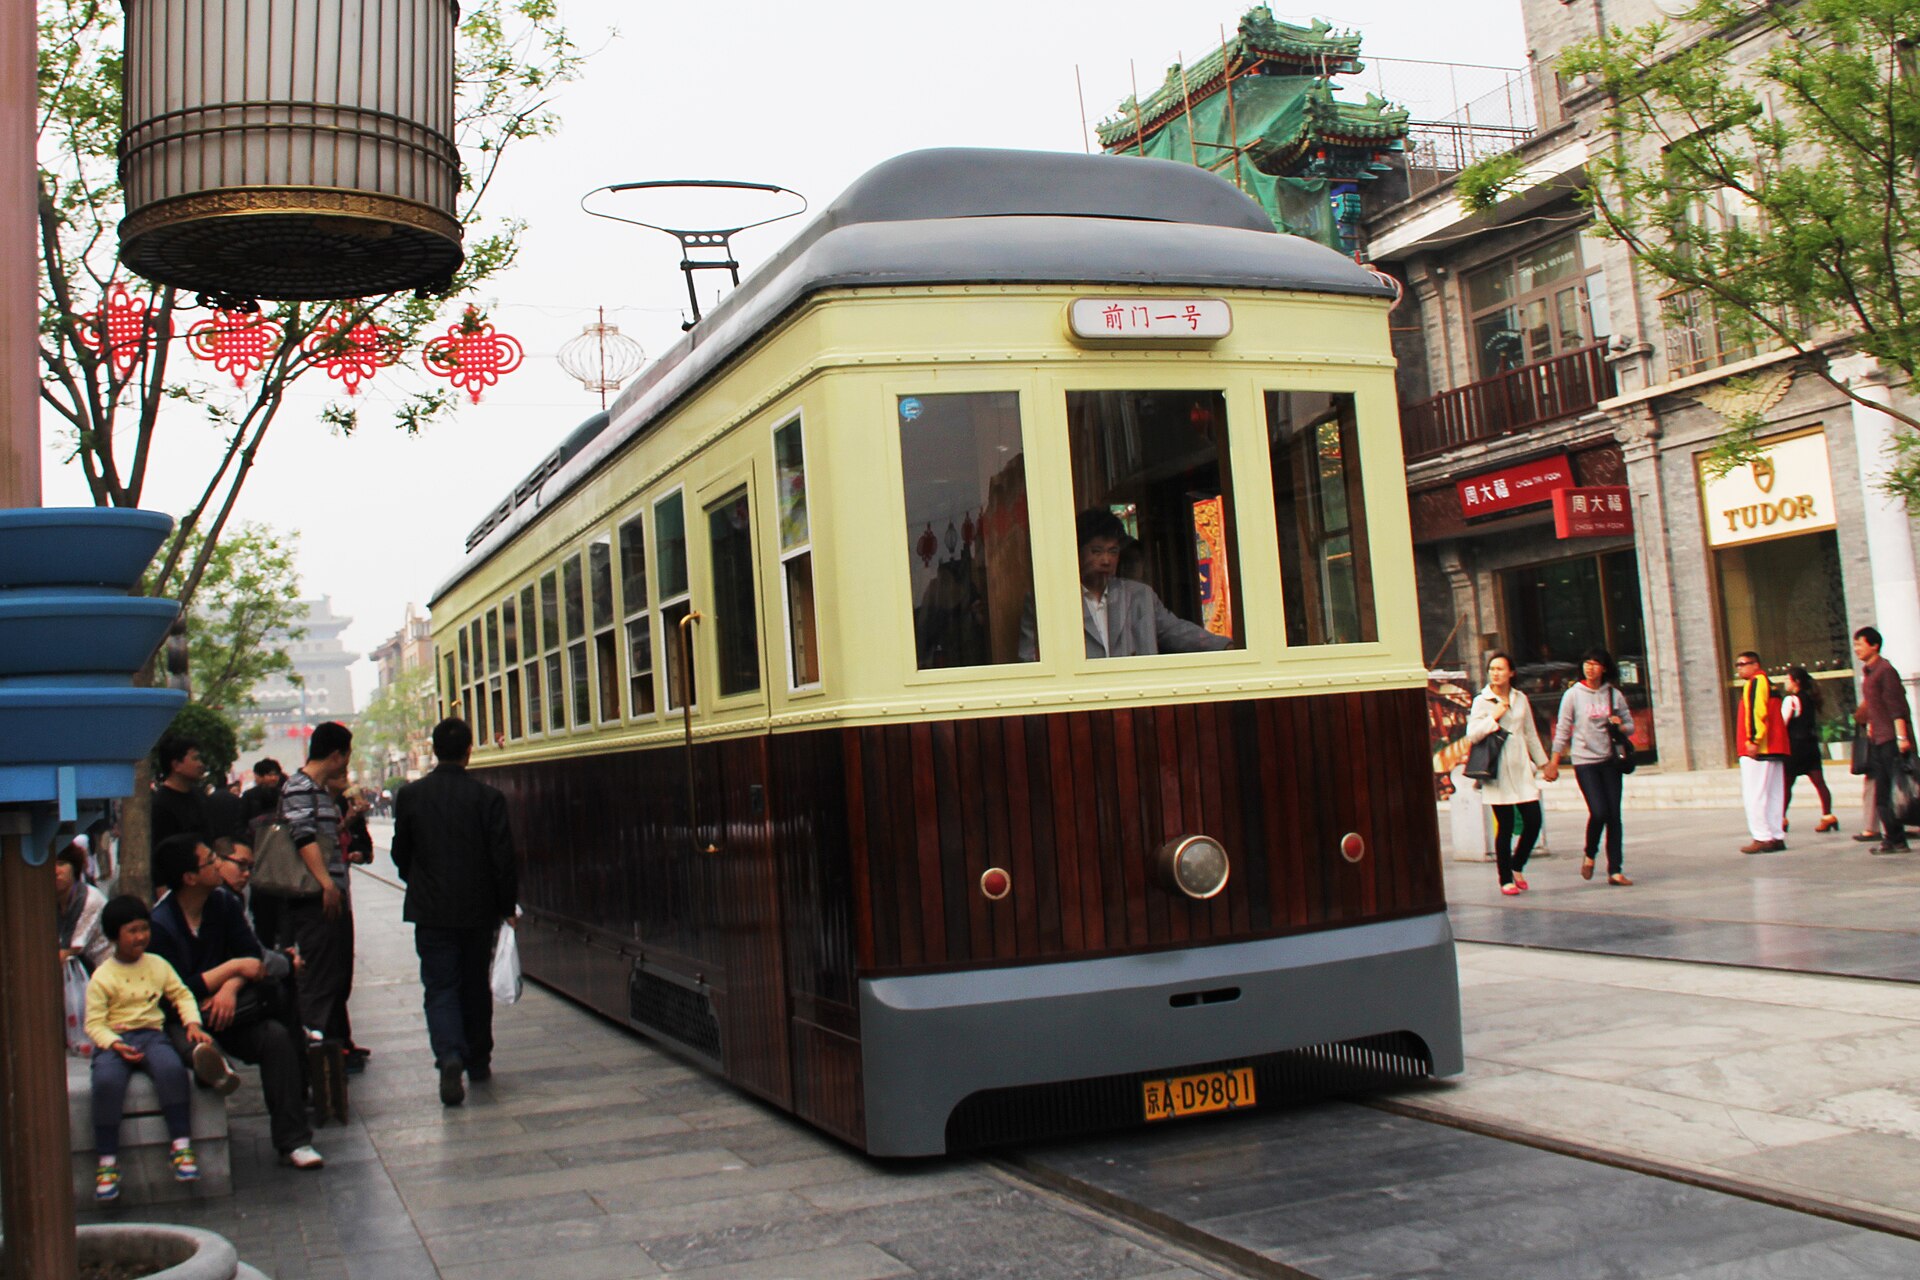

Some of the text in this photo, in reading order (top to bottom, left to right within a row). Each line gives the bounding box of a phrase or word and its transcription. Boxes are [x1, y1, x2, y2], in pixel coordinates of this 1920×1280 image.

[1102, 303, 1201, 331] 前门一号
[1464, 478, 1510, 506] 周大福
[1572, 494, 1623, 514] 周大福
[1722, 494, 1818, 532] TUDOR
